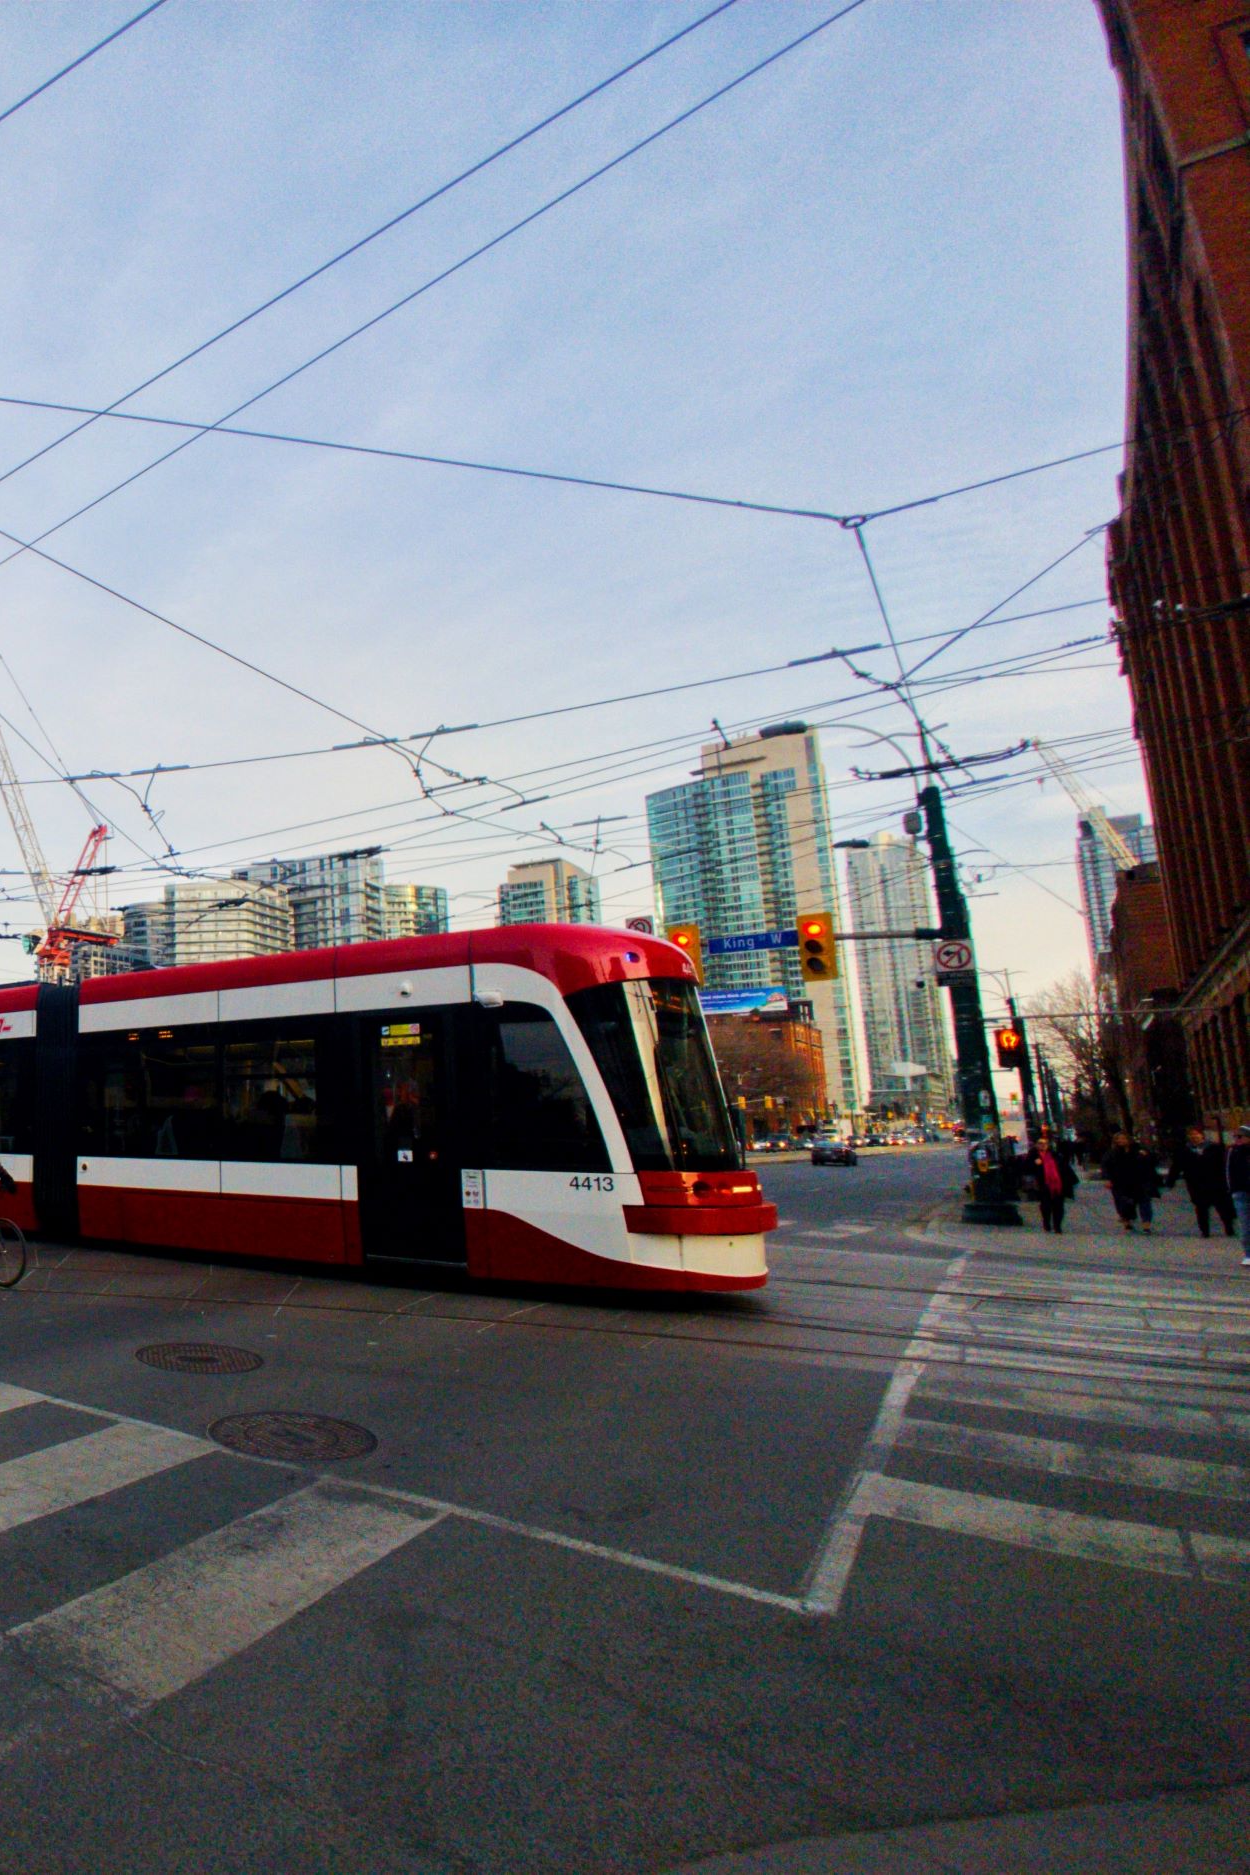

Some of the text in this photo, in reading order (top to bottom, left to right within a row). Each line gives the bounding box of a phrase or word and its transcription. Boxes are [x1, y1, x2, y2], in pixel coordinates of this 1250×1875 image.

[723, 937, 755, 949] King
[770, 932, 782, 944] W
[569, 1176, 614, 1192] 4413
